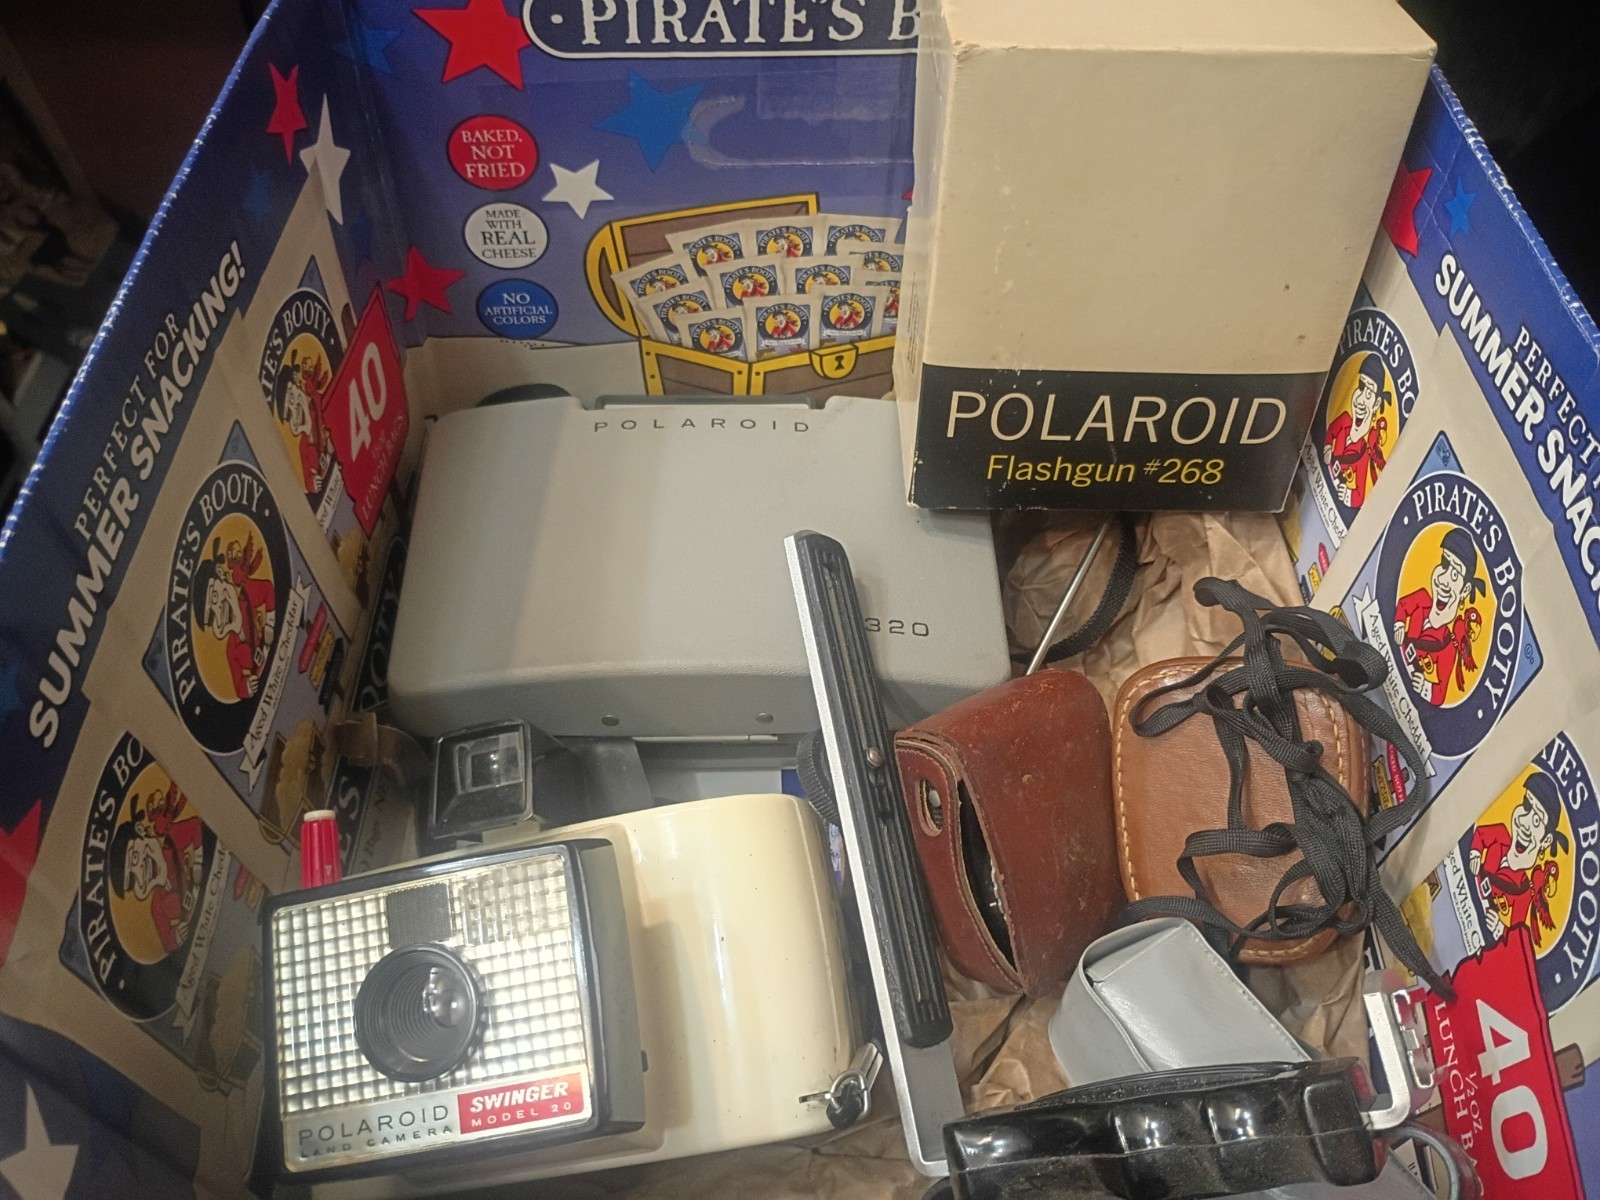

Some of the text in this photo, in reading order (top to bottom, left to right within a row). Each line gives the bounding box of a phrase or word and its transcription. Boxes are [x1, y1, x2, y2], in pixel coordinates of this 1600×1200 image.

[465, 162, 526, 179] FRIED
[471, 144, 515, 160] NOT
[485, 209, 520, 219] MADE
[485, 220, 522, 230] WITH
[480, 231, 536, 246] REAL
[481, 248, 537, 259] CHEESE
[484, 305, 553, 316] ARTIFICIAL
[502, 293, 531, 305] NO
[282, 299, 331, 340] BOOTY
[492, 315, 546, 325] COLORS
[1435, 254, 1545, 441] SUMMER
[349, 341, 387, 463] 40
[1513, 325, 1600, 464] PERFECT
[73, 312, 179, 542] PERFECT FOR
[593, 417, 810, 434] POLAROID
[946, 390, 1287, 446] POLAROID
[987, 454, 1225, 488] Flashgun #268
[28, 240, 246, 749] SUMMER SNACKING!
[1314, 472, 1332, 509] White
[171, 472, 264, 705] PIRATE'S BOOTY
[1413, 481, 1517, 711] PIRATE'S BOOTY
[864, 617, 930, 637] 320
[1369, 612, 1387, 651] Aged
[1398, 696, 1427, 754] Cheddar
[86, 789, 117, 985] PIRATE'S
[1456, 875, 1475, 930] White
[1561, 821, 1600, 980] BOOTY
[1434, 1001, 1468, 1120] LUNCH
[470, 1082, 569, 1114] SWINGER
[1475, 998, 1549, 1181] 40
[298, 1104, 449, 1146] POLAROID
[471, 1101, 572, 1127] MODEL 20
[1470, 1100, 1484, 1134] OZ
[300, 1125, 452, 1158] LAND CAMERA
